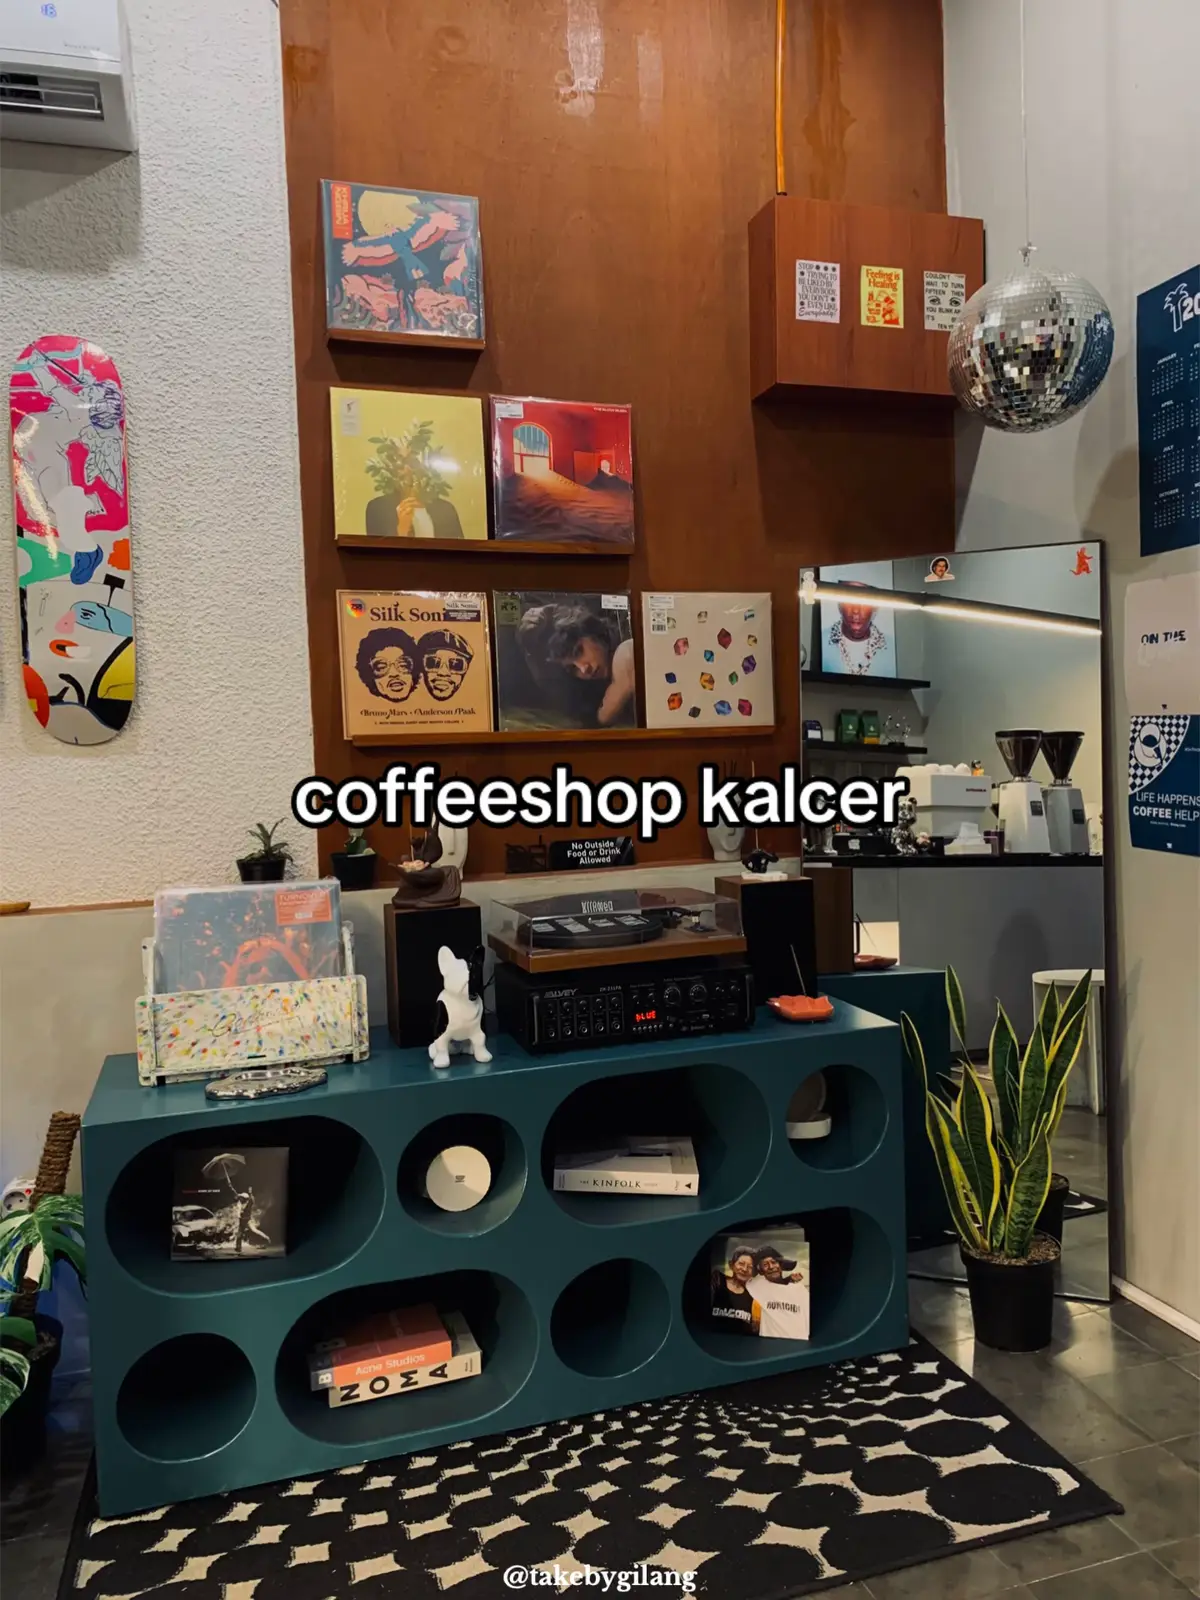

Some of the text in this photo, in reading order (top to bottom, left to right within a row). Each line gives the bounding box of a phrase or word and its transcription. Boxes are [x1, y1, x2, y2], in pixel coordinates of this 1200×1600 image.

[798, 262, 815, 270] STOP
[807, 271, 838, 281] TRYING TO
[866, 268, 901, 281] Feeling is
[868, 278, 898, 292] Healing
[807, 301, 823, 309] EVEN
[370, 601, 406, 622] Silk
[409, 607, 446, 622] Soni
[1141, 633, 1159, 645] ON
[1136, 791, 1156, 803] LIFE
[1133, 805, 1200, 821] COFFEE HELP
[571, 839, 614, 850] No Outside
[567, 846, 621, 858] Food or Drink
[579, 856, 611, 865] Allowed
[592, 1179, 641, 1188] KINFOLK
[355, 1353, 426, 1376] Acne Studios
[340, 1361, 449, 1402] NOMA
